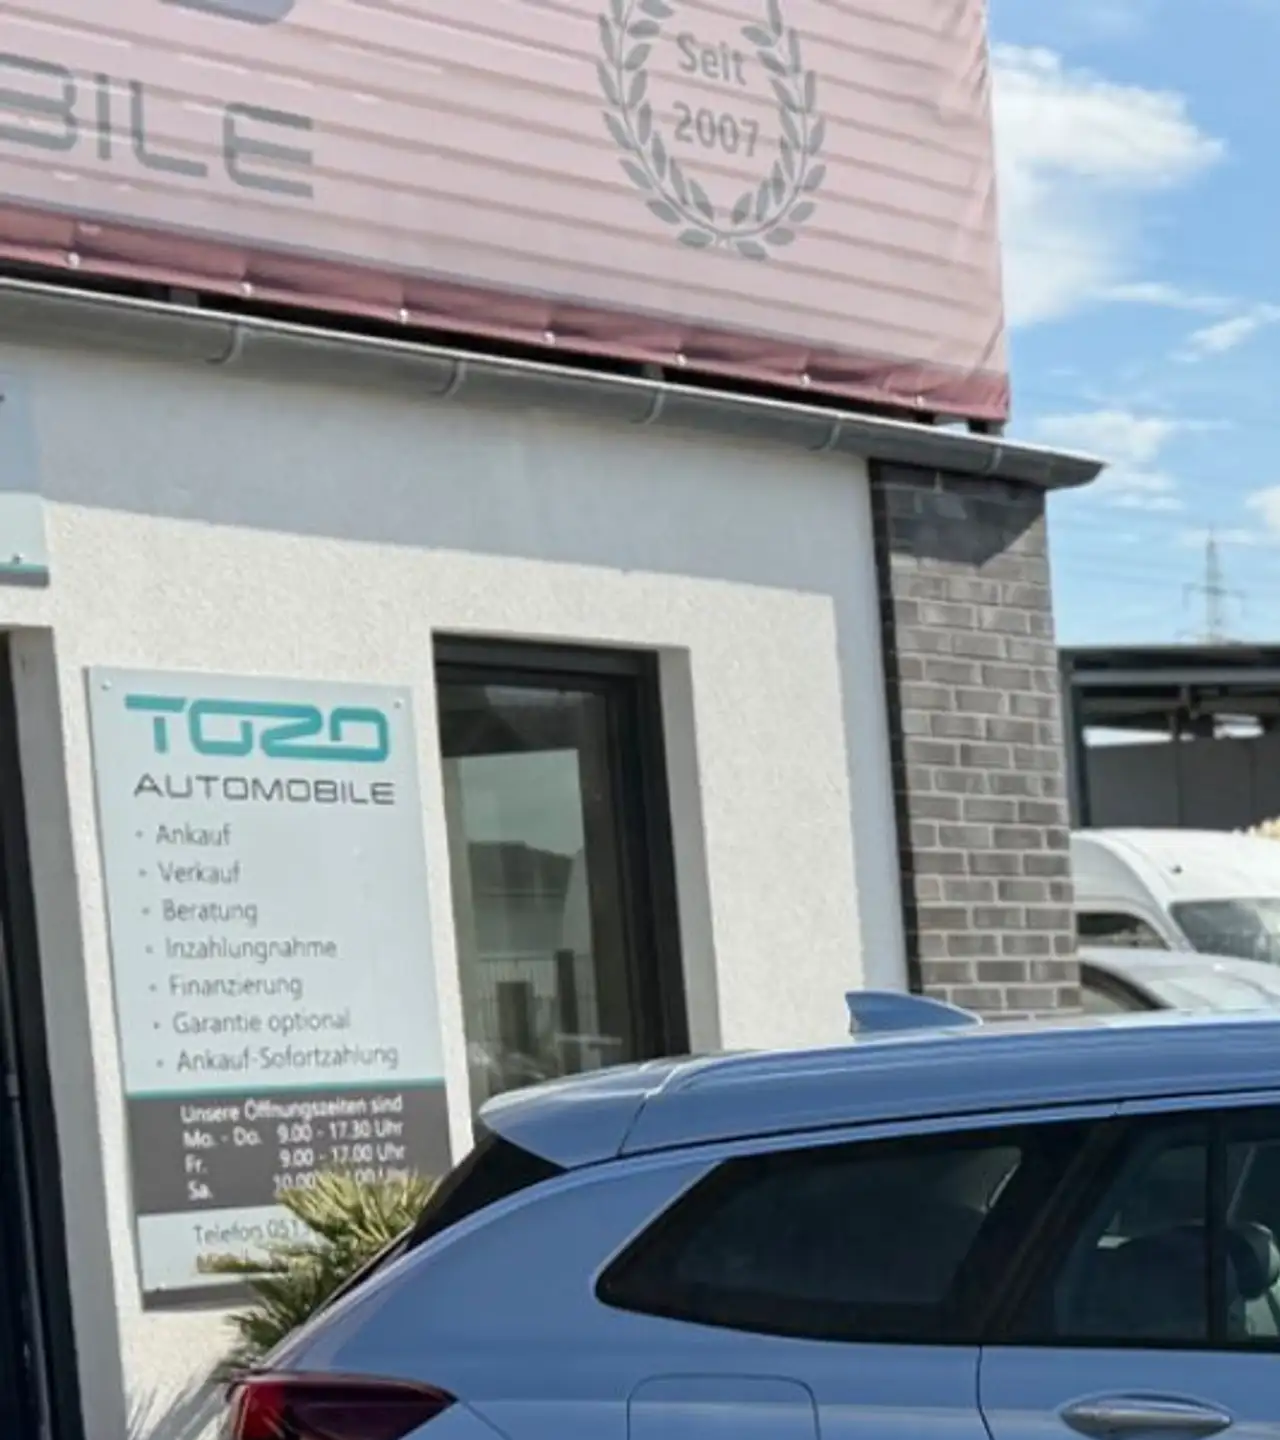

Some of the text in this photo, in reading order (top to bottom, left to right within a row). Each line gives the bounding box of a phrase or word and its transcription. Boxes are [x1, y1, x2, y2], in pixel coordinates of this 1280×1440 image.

[677, 32, 746, 86] Seit
[672, 100, 760, 157] 2007
[124, 694, 390, 762] TOZO
[133, 773, 396, 806] AUTOMOBILE
[156, 823, 231, 847] Ankauf
[157, 860, 240, 884] Verkauf
[162, 899, 258, 927] Beratung
[165, 936, 337, 964] Inzahlungnahme
[168, 974, 303, 1001] Finanzierung
[172, 1007, 350, 1036] Garantie optional
[177, 1045, 398, 1073] Ankauf-Sofortzahlung
[180, 1104, 240, 1123] Unsere
[277, 1121, 313, 1144] 9.00
[185, 1153, 208, 1173] Fr.
[279, 1147, 314, 1168] 9.00
[193, 1220, 263, 1246] Telefon
